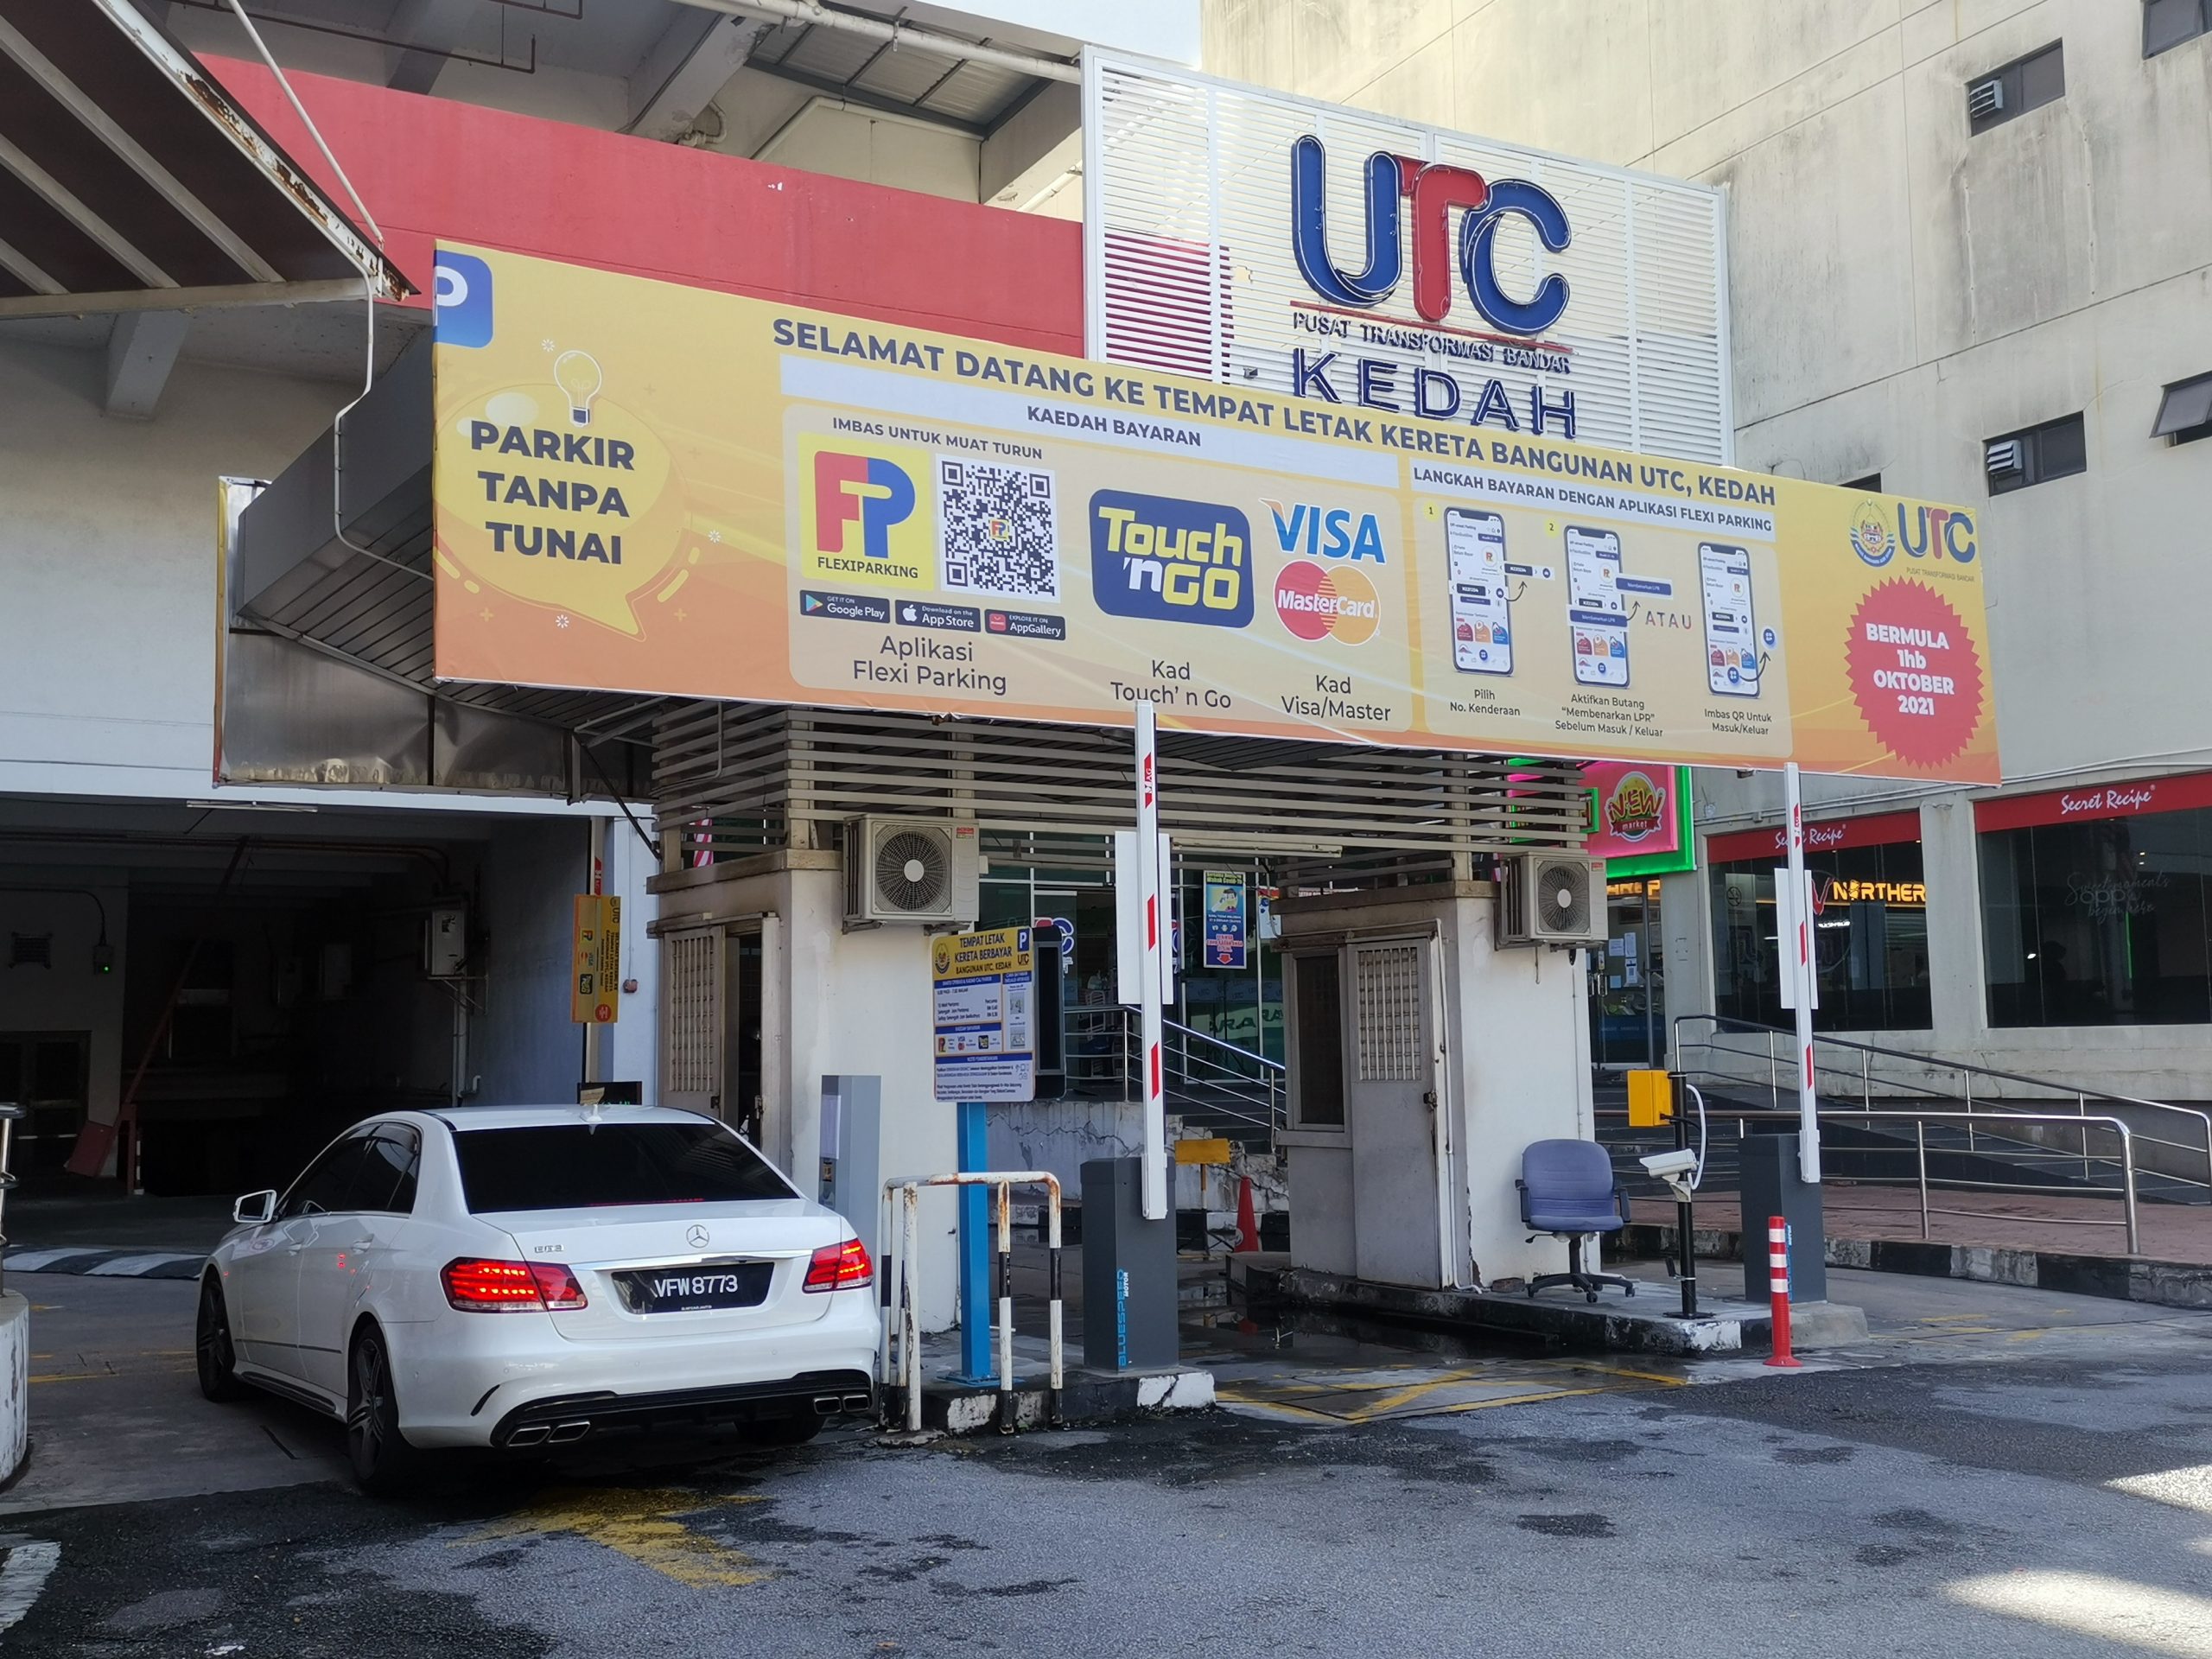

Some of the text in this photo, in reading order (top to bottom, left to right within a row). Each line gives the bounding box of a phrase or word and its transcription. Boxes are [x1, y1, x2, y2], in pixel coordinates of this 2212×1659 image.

[1291, 135, 1572, 336] UTC
[1294, 312, 1571, 374] PUSAT TRANSFORMASI BANDAR
[1294, 347, 1576, 439] KEDAH
[772, 318, 1776, 506] SELAMAT DATANG KE TEMPAT LETAK KERETA BANGUNAN UTC, KEDAH
[1027, 405, 1201, 448] KAEDAH BAYARAN
[470, 419, 636, 471] PARKIR
[832, 416, 1042, 460] IMBAS UNTUK MUAT TURUN
[477, 471, 630, 518] TANPA
[814, 450, 916, 559] FP
[1414, 467, 1772, 532] LANGKAH BAYARAN DENGAN APLIKASI FLEXI PARKING
[1098, 505, 1243, 567] Touch
[1260, 499, 1386, 565] VISA
[1548, 523, 1554, 531] 2
[1897, 502, 1976, 563] UTC
[485, 520, 623, 564] TUNAI
[817, 556, 918, 579] FLEXIPARKING
[827, 603, 885, 620] Google Play
[922, 605, 952, 614] Download
[1277, 588, 1376, 620] MasterCard
[922, 613, 974, 628] App Store
[1009, 614, 1032, 623] EXPLORE
[1645, 610, 1693, 630] ATAU
[1009, 622, 1062, 638] AppGallery
[1866, 622, 1949, 650] BERMULA
[880, 635, 973, 662] Aplikasi
[1897, 649, 1927, 670] 1hb
[853, 659, 1007, 696] Flexi Parking
[1151, 659, 1191, 681] Kad
[1316, 675, 1351, 695] Kad
[1873, 670, 1955, 695] OKTOBER
[1186, 692, 1198, 707] n
[1205, 690, 1231, 709] Go
[1474, 688, 1496, 700] Pilih
[1571, 694, 1645, 710] Aktifkan Butang
[1897, 695, 1935, 715] 2021
[1281, 696, 1390, 721] Visa/Master
[1450, 702, 1521, 716] No. Kenderaan
[1704, 708, 1773, 723] Imbas QR Untuk
[1555, 720, 1595, 733] Sebelum
[1598, 722, 1628, 734] Masuk
[1635, 726, 1663, 738] Keluar
[1712, 722, 1769, 735] Masuk/Keluar
[1608, 788, 1664, 823] NEW
[2061, 789, 2152, 815] Secret Recipe
[1622, 819, 1648, 830] market
[1809, 827, 1844, 846] Recipe
[960, 933, 1005, 948] TEMPAT LETAK
[1020, 932, 1027, 949] P
[955, 947, 1013, 963] KERETA BERBAYAR
[1017, 953, 1029, 966] UTC
[956, 964, 983, 975] BANGUNAN
[995, 962, 1012, 970] KEDAH
[1117, 1268, 1126, 1366] BLUESPEED
